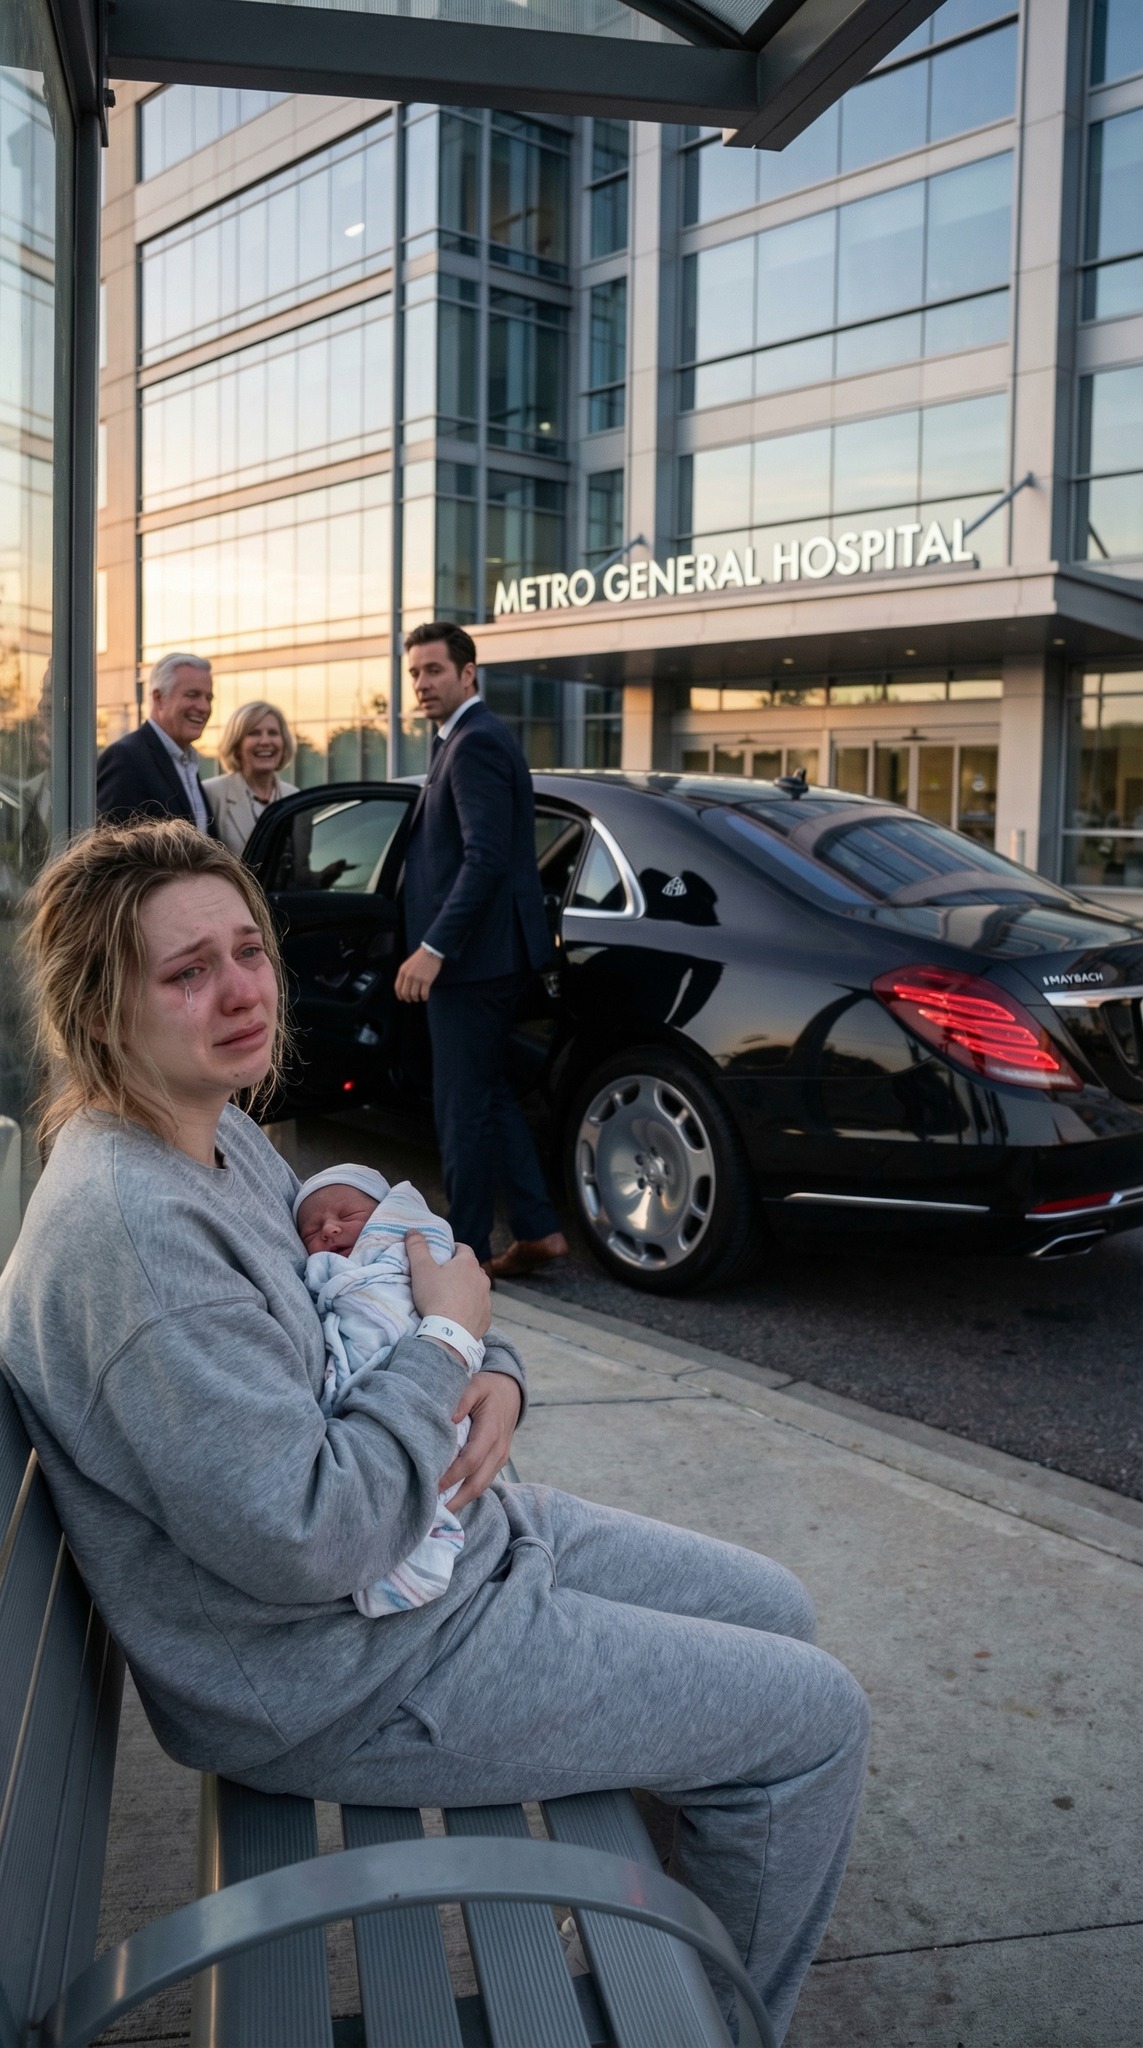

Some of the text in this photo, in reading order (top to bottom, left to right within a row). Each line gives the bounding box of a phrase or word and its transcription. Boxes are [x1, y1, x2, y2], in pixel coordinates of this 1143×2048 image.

[494, 517, 974, 616] METRO GENERAL HOSPITAL
